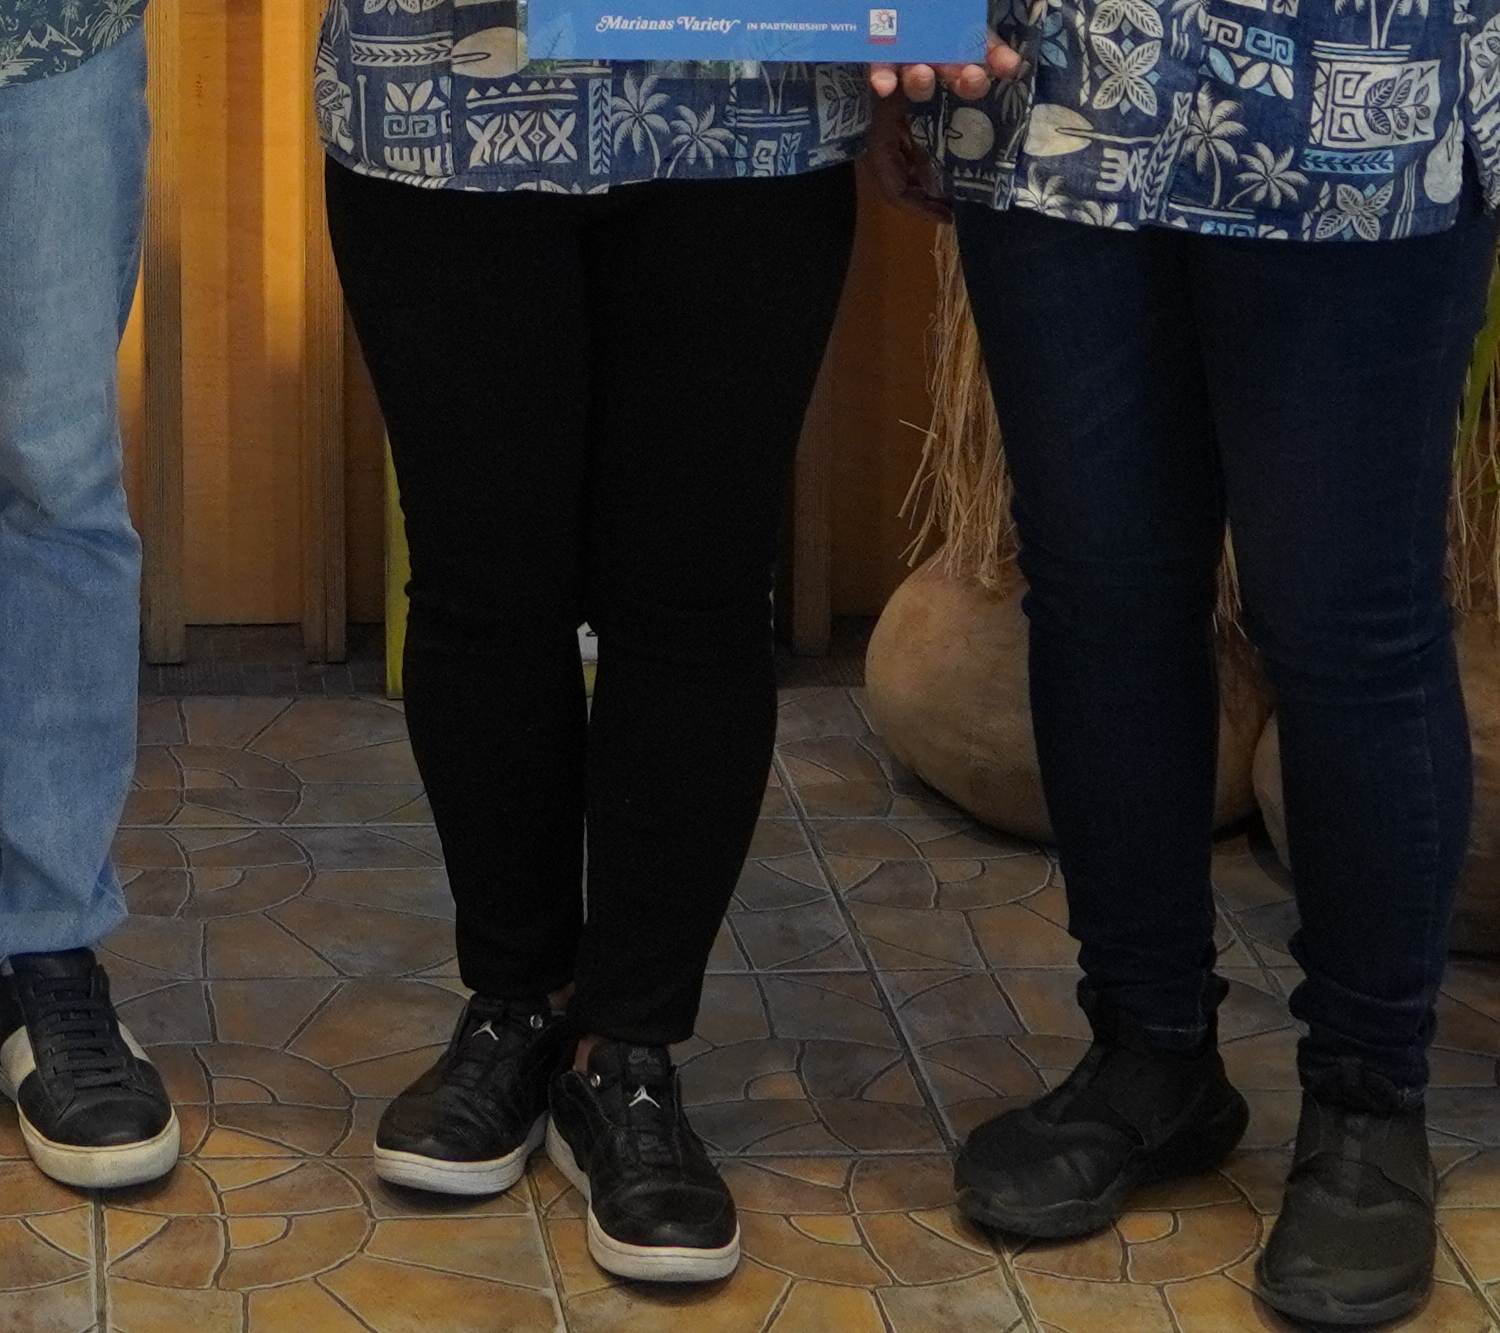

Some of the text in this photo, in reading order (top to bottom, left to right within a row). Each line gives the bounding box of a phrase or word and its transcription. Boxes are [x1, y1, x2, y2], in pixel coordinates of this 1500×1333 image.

[596, 15, 675, 32] Marianas
[677, 16, 741, 33] Variety
[760, 23, 829, 31] PARTNERSHIP
[830, 23, 857, 31] WITH
